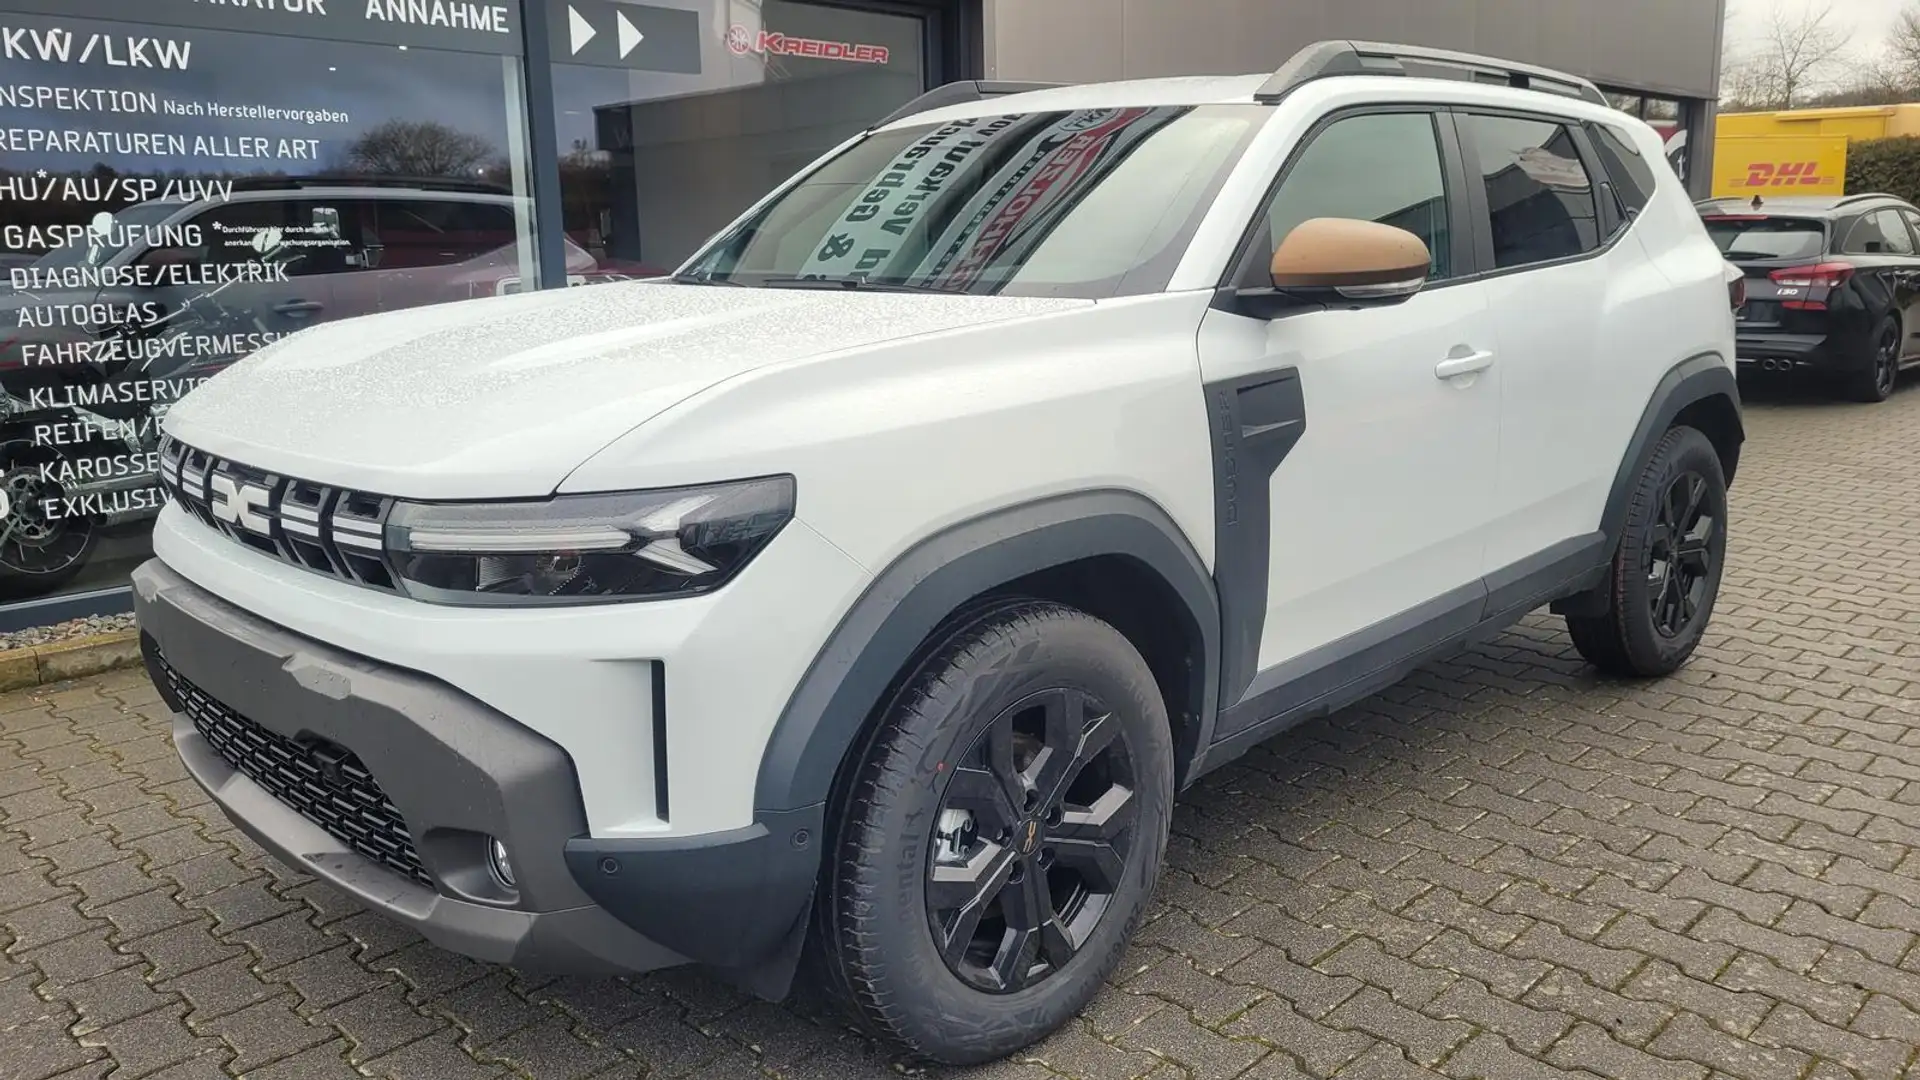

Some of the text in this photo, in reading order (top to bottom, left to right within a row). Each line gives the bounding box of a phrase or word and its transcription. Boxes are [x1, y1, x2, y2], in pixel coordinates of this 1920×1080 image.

[365, 0, 510, 33] ANNAHME
[755, 31, 889, 65] KREIDLER
[163, 100, 204, 117] Nach
[207, 102, 349, 125] Herstellervorgaben
[193, 135, 270, 158] ALLER
[277, 139, 320, 160] ART
[1745, 162, 1821, 187] DHL
[10, 262, 290, 290] DIAGNOSE/ELEKTRIK
[17, 301, 159, 328] AUTOGLAS
